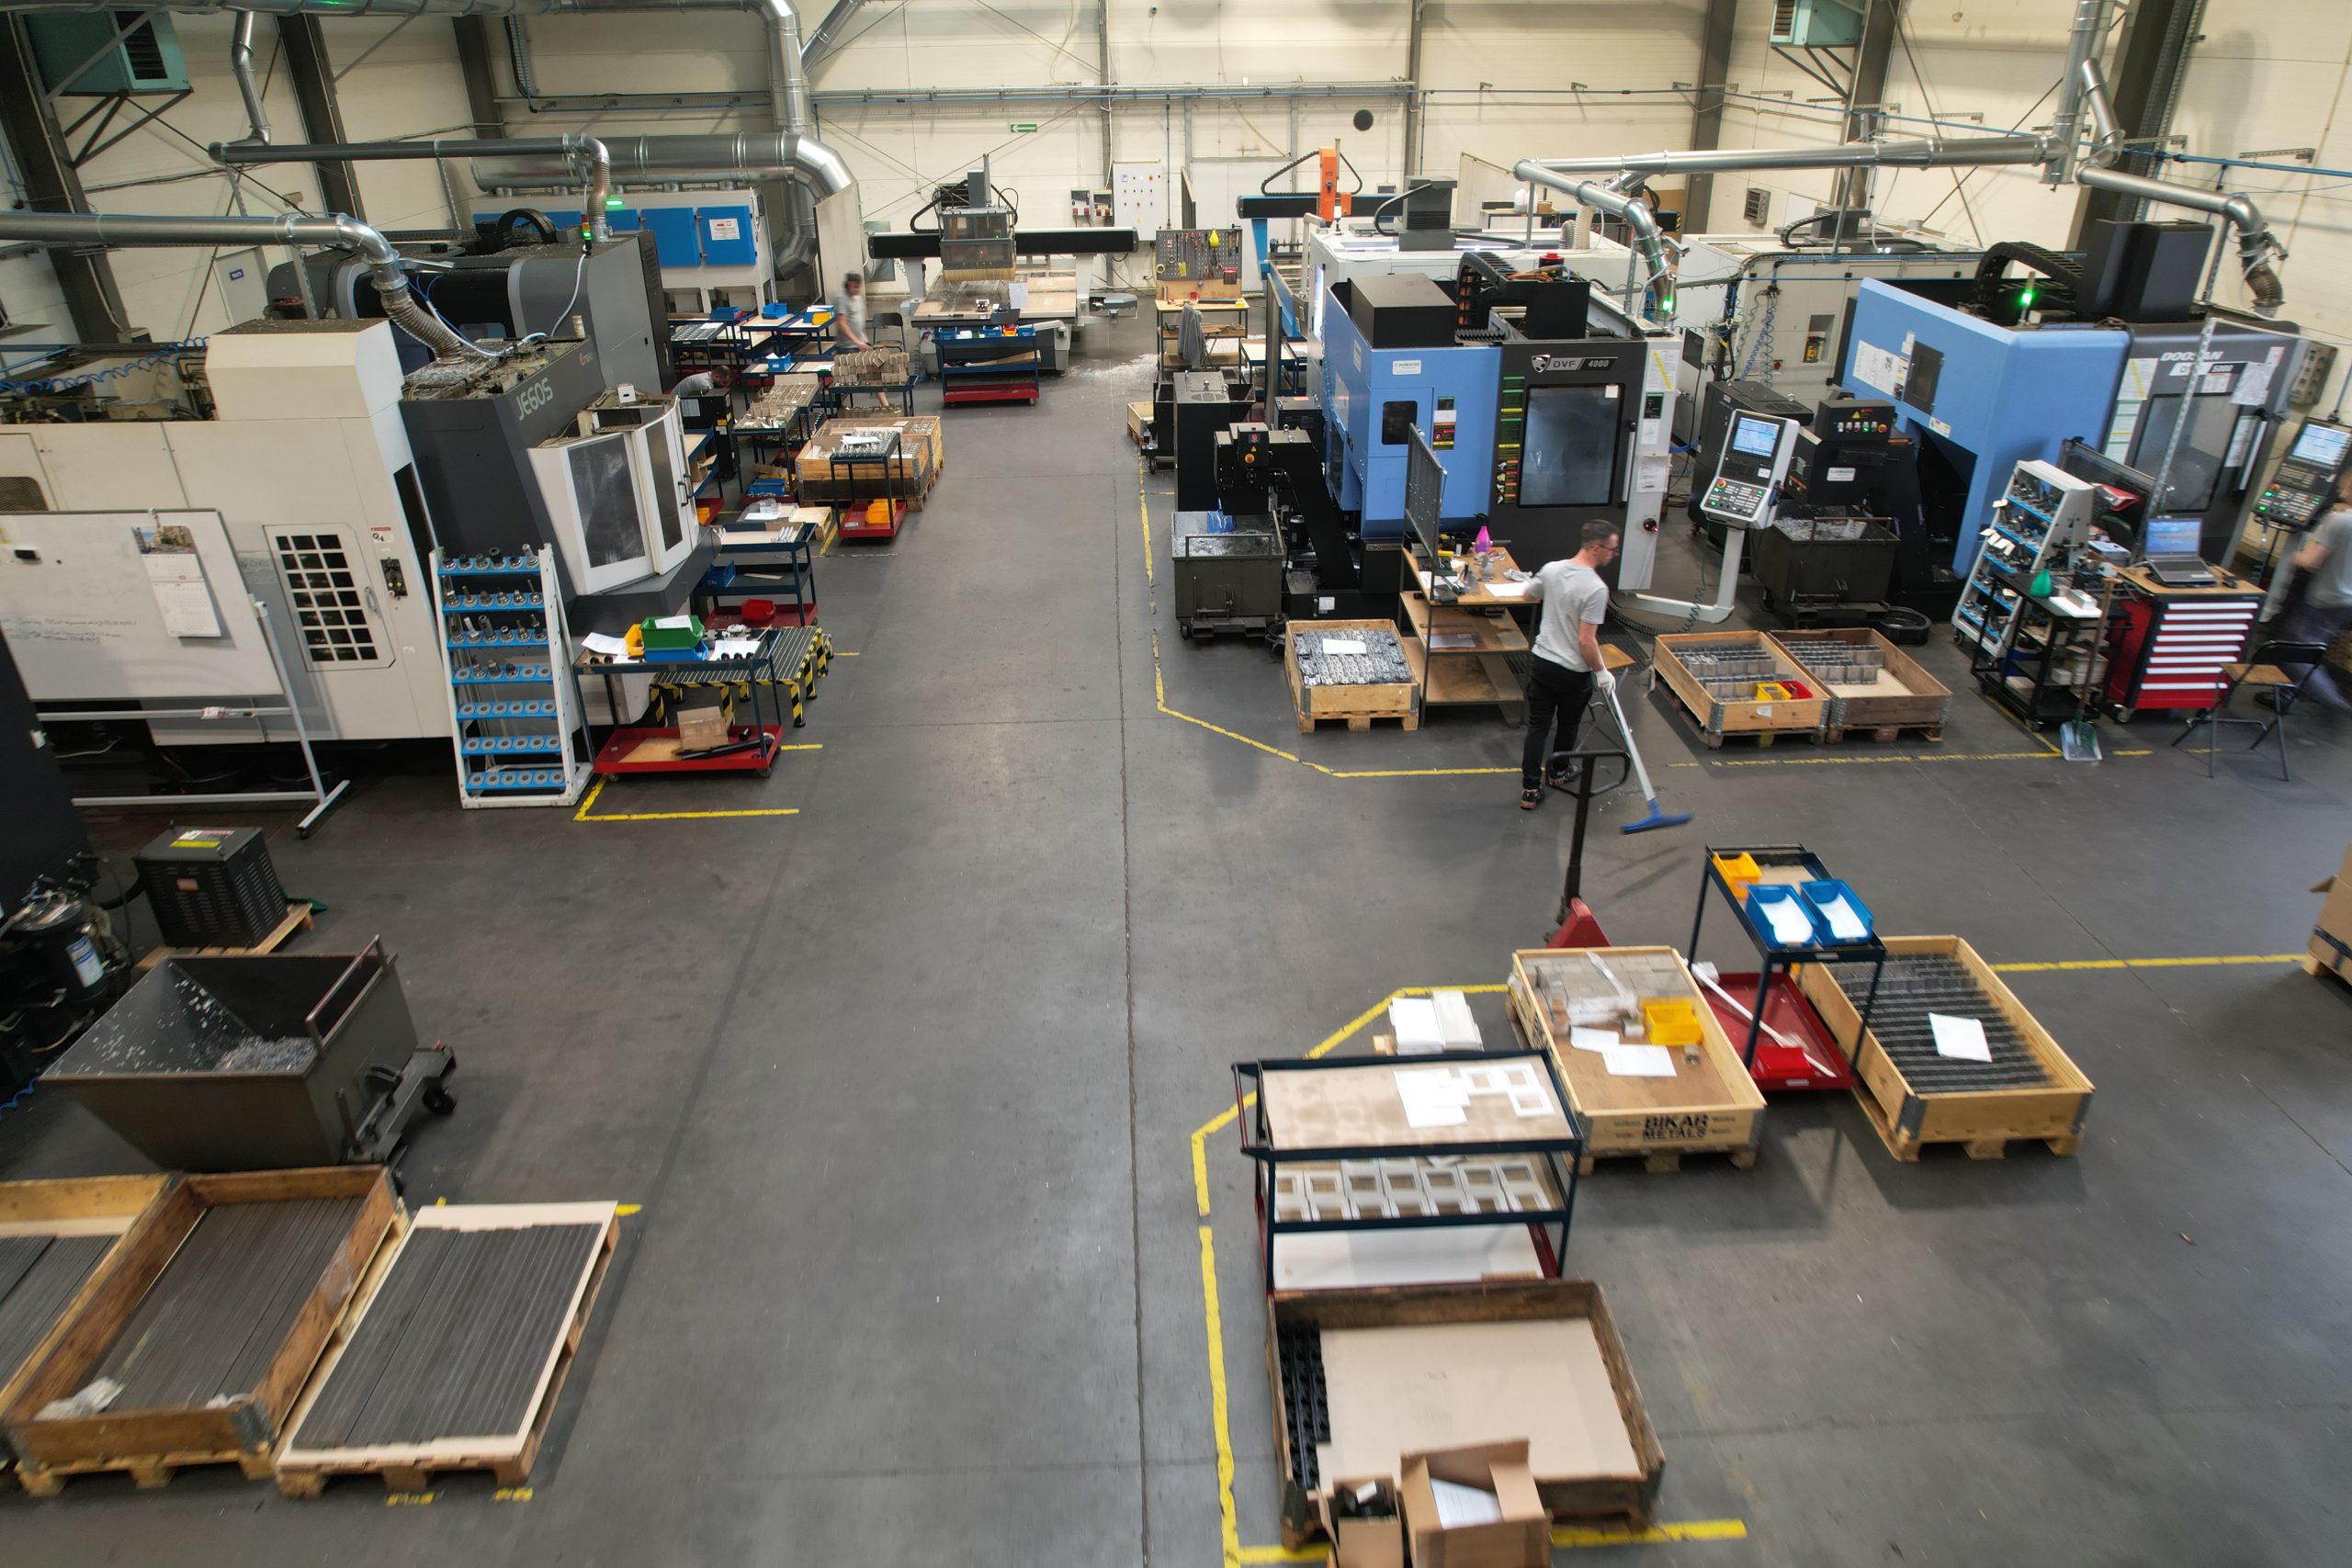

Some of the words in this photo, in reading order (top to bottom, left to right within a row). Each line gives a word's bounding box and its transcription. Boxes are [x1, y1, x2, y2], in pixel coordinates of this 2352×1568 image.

[1553, 360, 1577, 368] DVF
[1588, 359, 1610, 368] 4000
[1645, 1113, 1709, 1129] BIKAR
[1643, 1125, 1707, 1140] METALS
